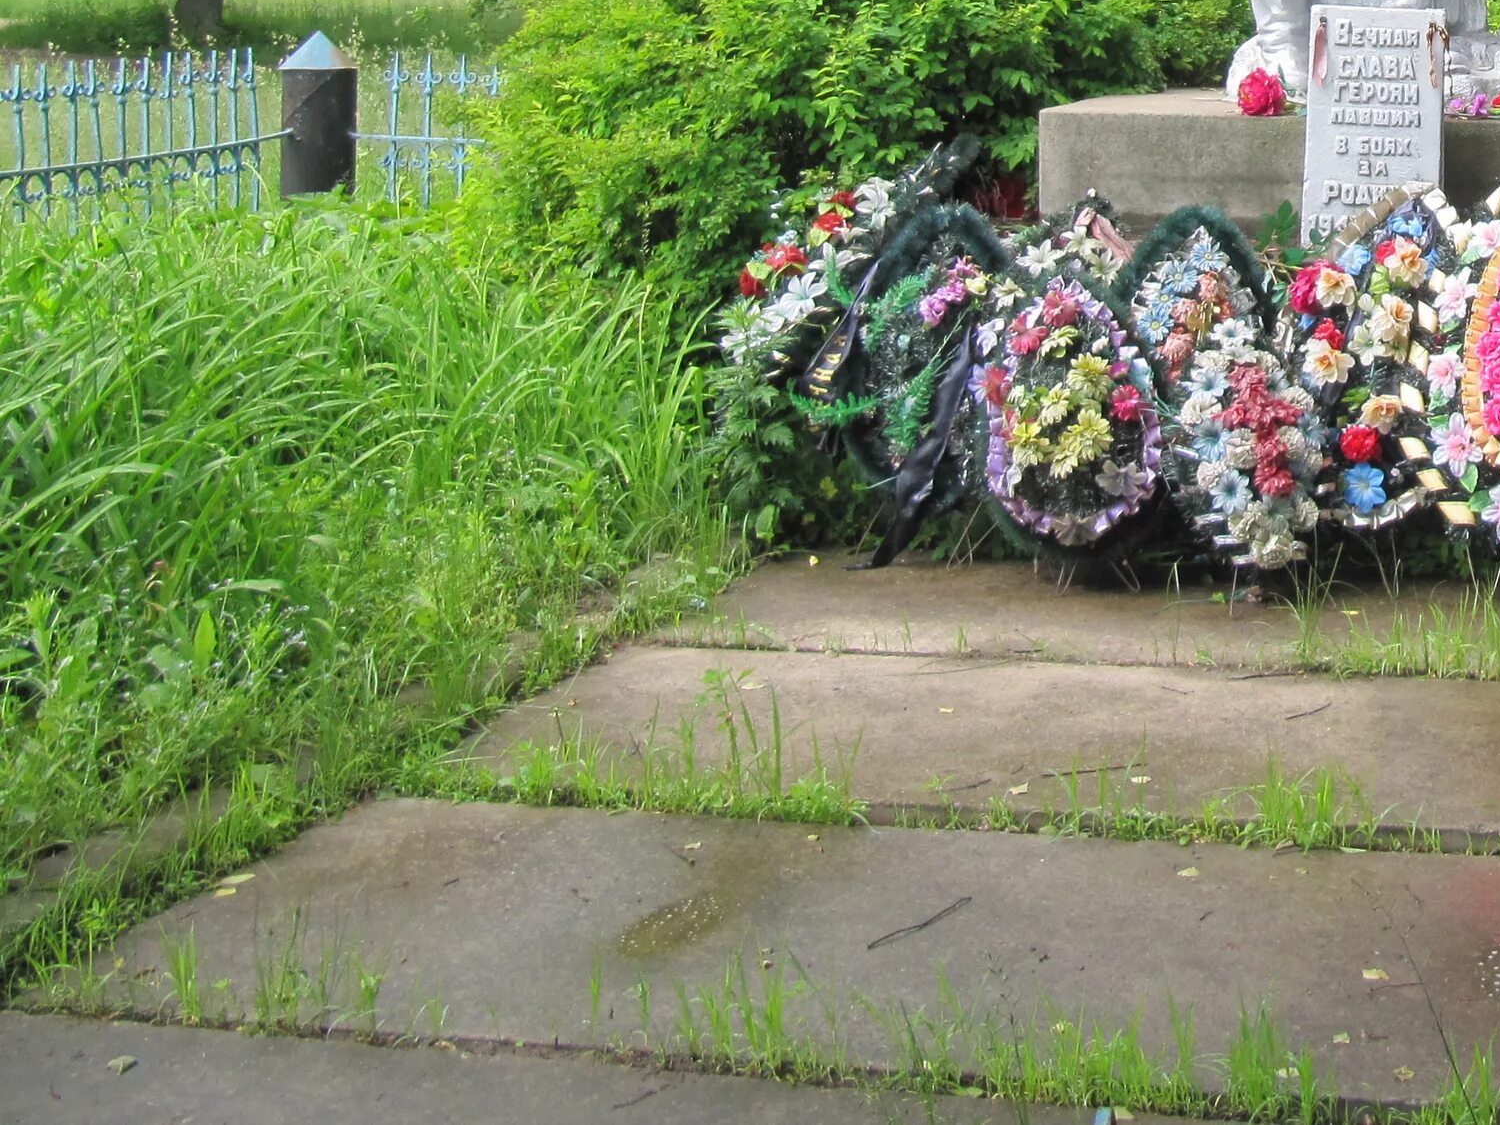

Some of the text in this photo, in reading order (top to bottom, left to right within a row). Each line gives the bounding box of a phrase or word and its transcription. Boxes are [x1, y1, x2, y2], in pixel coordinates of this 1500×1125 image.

[1338, 55, 1416, 80] СЛАВА
[1334, 80, 1420, 105] ГЕРОЯМ
[1331, 107, 1421, 128] ПАВШИМ
[1336, 135, 1412, 156] В БОЯХ
[1358, 160, 1389, 177] ЗА
[1323, 179, 1400, 206] РОДИ
